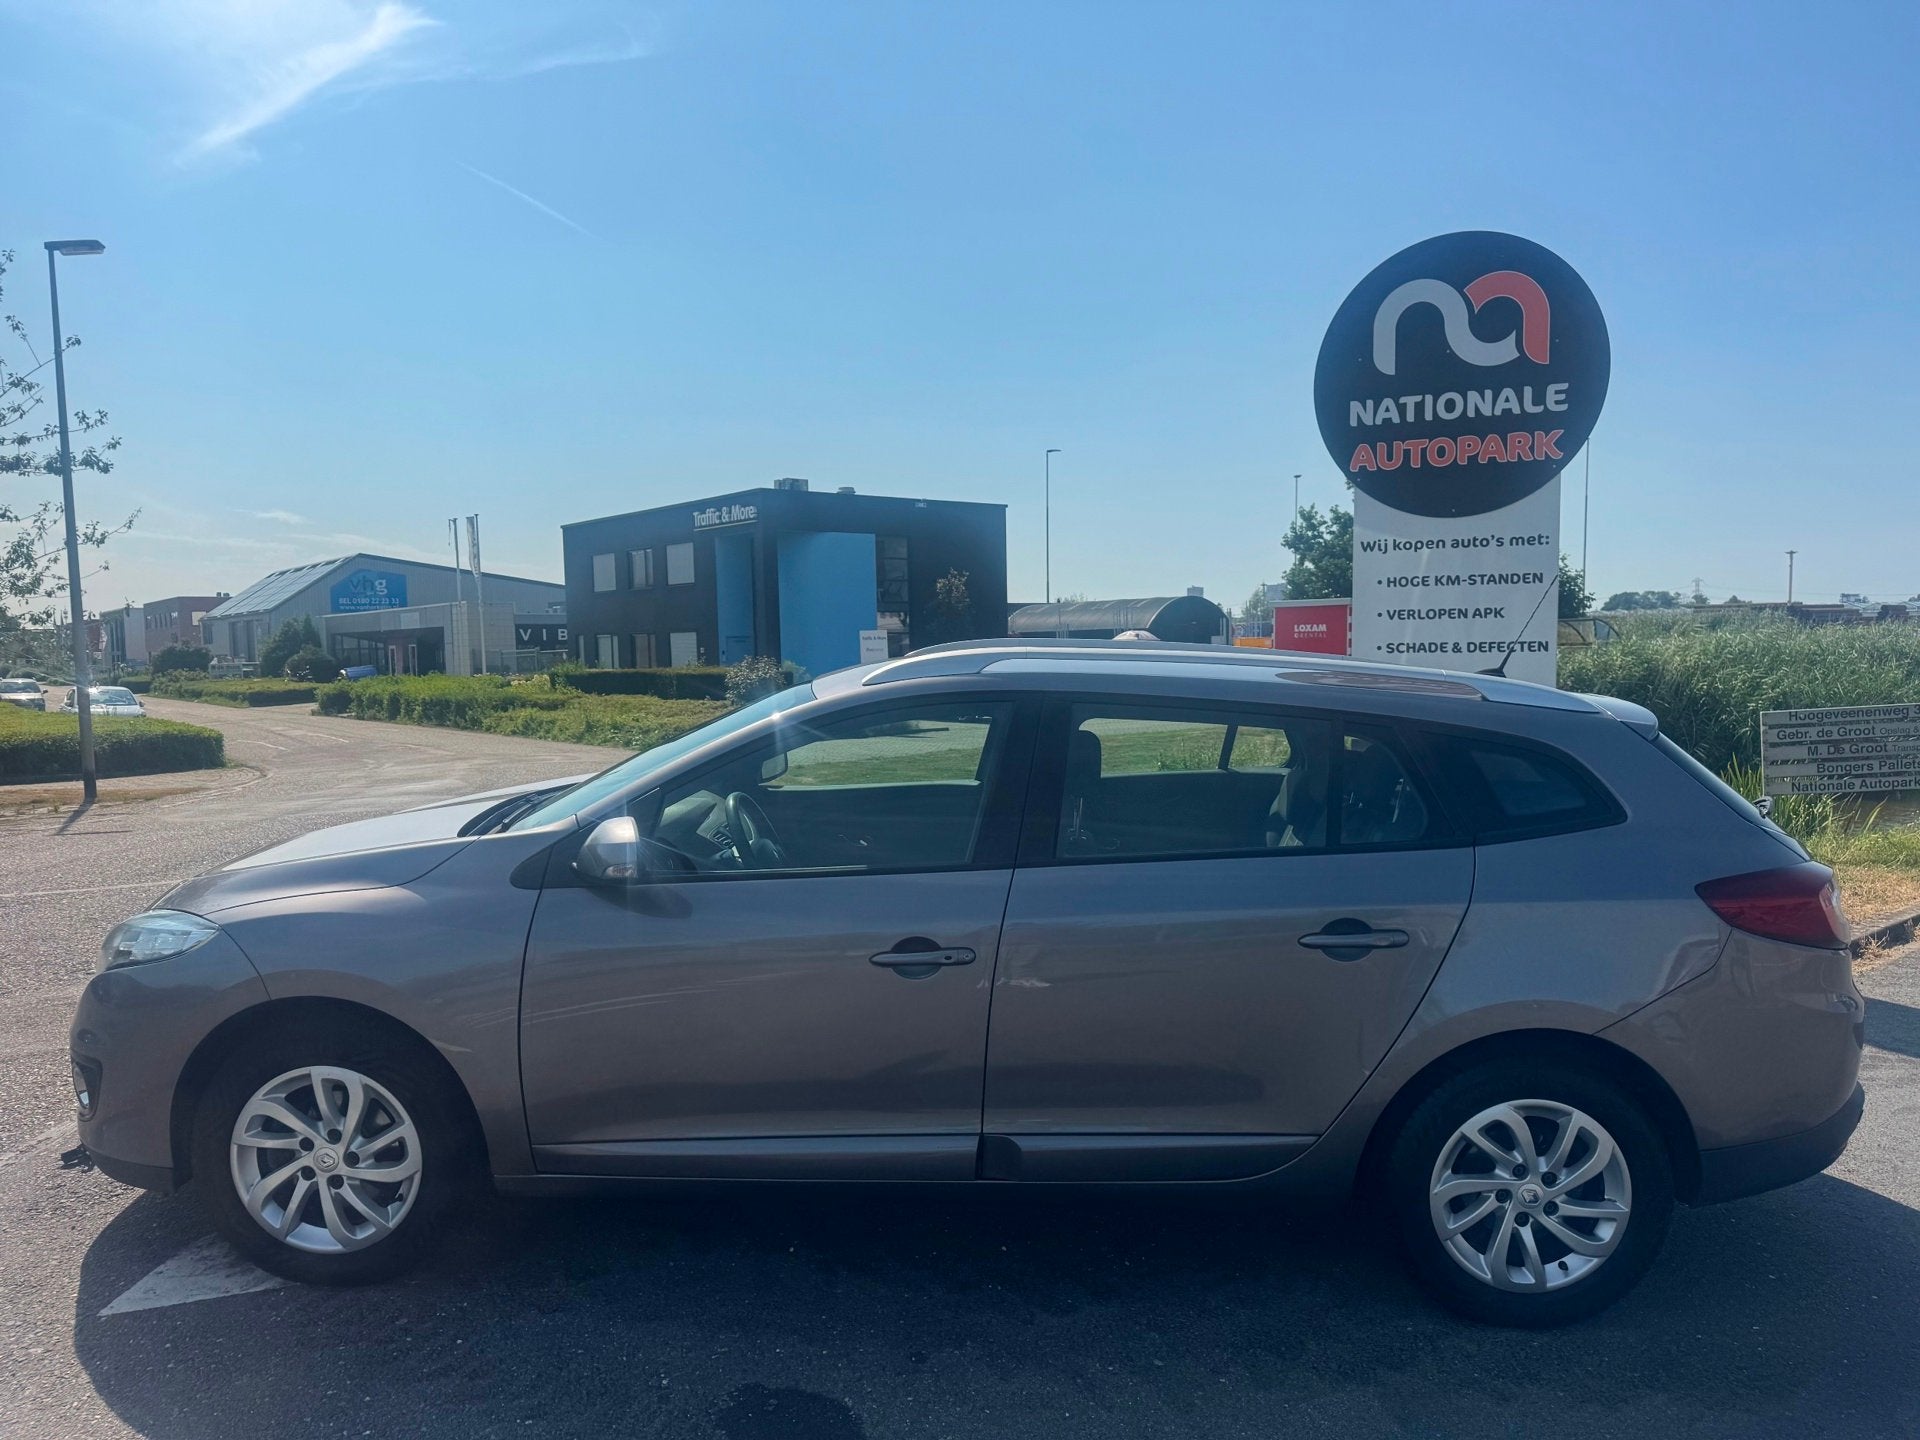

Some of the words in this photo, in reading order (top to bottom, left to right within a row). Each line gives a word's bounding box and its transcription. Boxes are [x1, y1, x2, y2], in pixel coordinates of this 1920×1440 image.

[1350, 383, 1569, 426] NATIONALE
[1350, 429, 1564, 472] AUTOPARK
[692, 508, 721, 527] Traffic
[721, 506, 730, 523] &
[731, 504, 757, 521] More
[1360, 538, 1388, 554] Wij
[1392, 538, 1446, 552] kopen
[1450, 534, 1505, 549] auto's
[1509, 533, 1550, 546] met:
[350, 575, 388, 595] vhg
[1386, 575, 1431, 588] HOGE
[1434, 572, 1544, 587] KM-STANDEN
[1386, 608, 1469, 621] VERLOPEN
[1472, 607, 1505, 619] APK
[1294, 624, 1327, 632] LOXAM
[1386, 642, 1449, 654] SCHADE
[1451, 642, 1464, 654] &
[1466, 641, 1549, 653] DEFECTEN
[1788, 706, 1910, 722] Hoogeveenenweg
[1776, 728, 1812, 741] Gebr.
[1816, 728, 1833, 738] de
[1837, 726, 1876, 738] Groot
[1807, 745, 1822, 757] M.
[1827, 744, 1845, 755] De
[1849, 742, 1888, 754] Groot
[1817, 762, 1874, 775] Bongers
[1791, 779, 1856, 792] Nationale
[1859, 776, 1920, 791] Autopark
